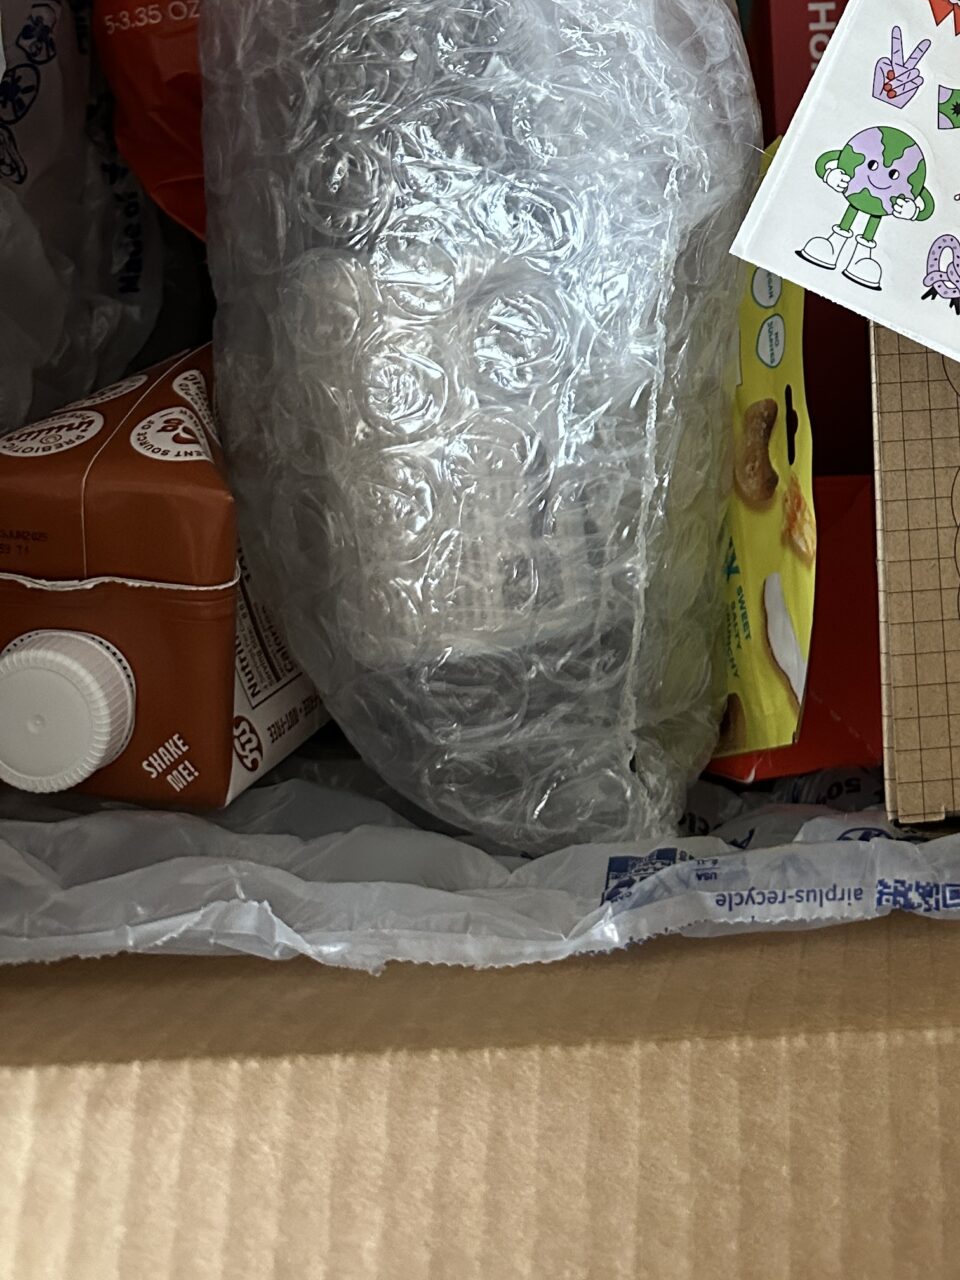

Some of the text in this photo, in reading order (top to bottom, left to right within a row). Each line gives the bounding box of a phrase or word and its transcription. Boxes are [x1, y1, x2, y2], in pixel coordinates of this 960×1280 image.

[105, 0, 201, 35] 5-3.35 OZ
[808, 2, 836, 69] Ho
[766, 271, 774, 299] EGAN
[2, 433, 86, 455] PREBIOTIC
[731, 601, 742, 650] SALTY
[736, 585, 752, 640] SWEET
[141, 733, 190, 779] SHAKE
[166, 760, 200, 792] ME!
[715, 884, 864, 913] airplus-recycle
